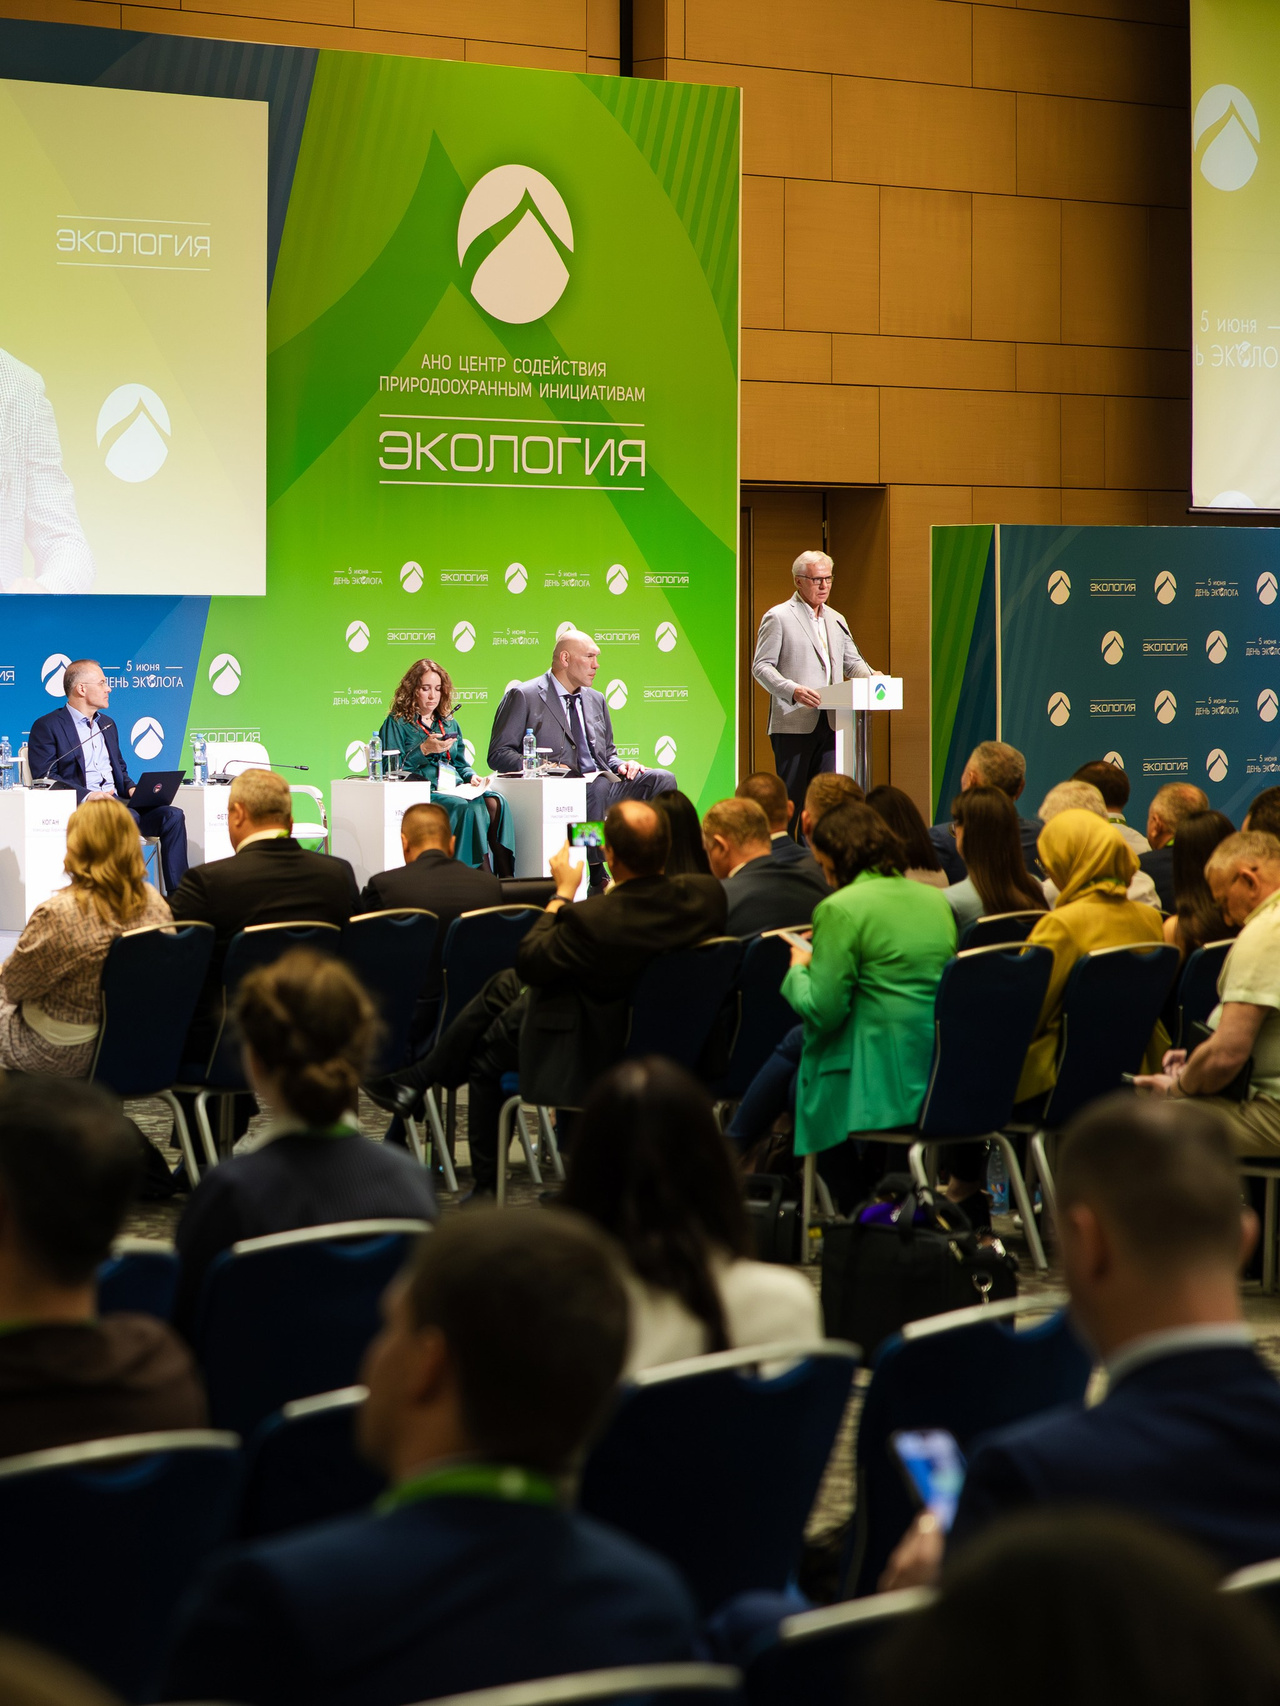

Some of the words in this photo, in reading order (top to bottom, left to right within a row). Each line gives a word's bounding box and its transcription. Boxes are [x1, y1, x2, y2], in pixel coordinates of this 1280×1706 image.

[56, 229, 211, 258] ЭКОЛОГИЯ
[1200, 310, 1209, 332] 5
[1217, 318, 1257, 333] июня
[1211, 341, 1279, 368] ЭКОЛО
[421, 354, 451, 370] АНО
[459, 355, 506, 373] ЦЕНТР
[513, 356, 607, 377] СОДЕЙСТВИЯ
[379, 376, 532, 398] ПРИРОДООХРАННЫМ
[540, 383, 645, 402] ИНИЦИАТИВАМ
[379, 430, 646, 477] ЭКОЛОГИЯ
[440, 574, 488, 582] ЭКОЛОГИЯ
[644, 576, 690, 584] ЭКОЛОГИЯ
[1090, 583, 1136, 592] ЭКОЛОГИЯ
[387, 632, 436, 641] ЭКОЛОГИЯ
[594, 632, 640, 641] ЭКОЛОГИЯ
[1142, 643, 1188, 652] ЭКОЛОГИЯ
[1262, 646, 1279, 656] ЭКОЛ
[126, 660, 132, 672] 5
[136, 664, 160, 672] июня
[132, 674, 184, 688] ЭКОЛОГА
[452, 692, 488, 700] ОЛОГИЯ
[644, 690, 688, 698] ЭКОЛОГИЯ
[1090, 704, 1136, 712] ЭКОЛОГИЯ
[190, 732, 260, 743] ЭКОЛОГИЯ
[617, 748, 640, 756] ОГИЯ
[1142, 762, 1188, 772] ЭКОЛОГИЯ
[1262, 764, 1279, 773] ЭКОЛ
